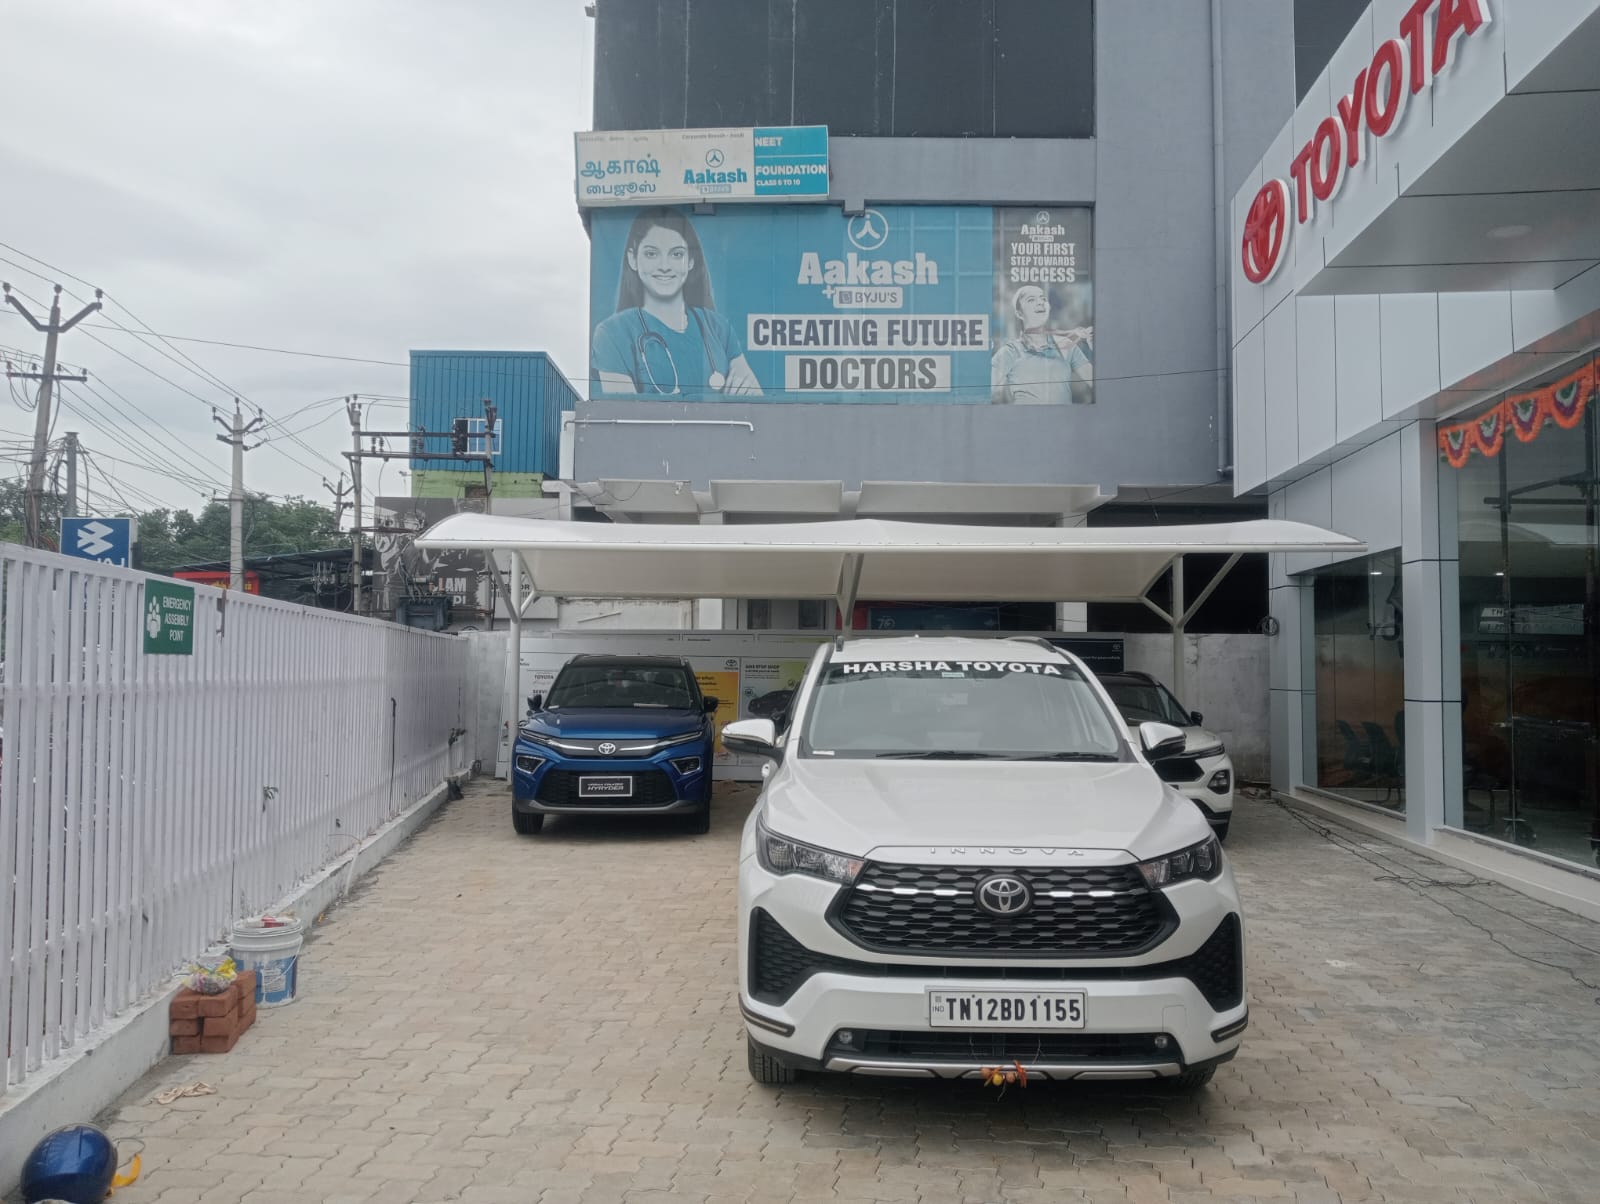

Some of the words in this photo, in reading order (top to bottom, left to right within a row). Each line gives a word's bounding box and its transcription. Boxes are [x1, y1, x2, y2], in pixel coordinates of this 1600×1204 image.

[1290, 0, 1490, 225] TOYOTA
[754, 136, 783, 147] NEET
[580, 153, 661, 180] ஆகாஷ்
[755, 164, 827, 176] FOUNDATION
[683, 167, 748, 185] Aakash
[1021, 223, 1065, 236] Aakash
[1010, 242, 1041, 256] YOUR
[1043, 242, 1076, 256] FIRST
[797, 252, 939, 285] Aakash
[1010, 256, 1032, 267] STEP
[1032, 256, 1076, 267] TOWARDS
[1010, 267, 1076, 283] SUCCESS
[855, 292, 898, 304] BYJU'S
[753, 318, 878, 347] CREATING
[887, 319, 984, 346] FUTURE
[799, 358, 938, 390] DOCTORS
[162, 596, 193, 611] EMERGENCY
[165, 612, 190, 626] ASSEMBLY
[169, 629, 185, 641] POINT
[843, 661, 952, 674] HARSHA
[956, 661, 1062, 675] TOYOTA
[930, 847, 1085, 857] INNOVA
[932, 1005, 945, 1013] IND
[946, 997, 1081, 1022] TN12BD1155
